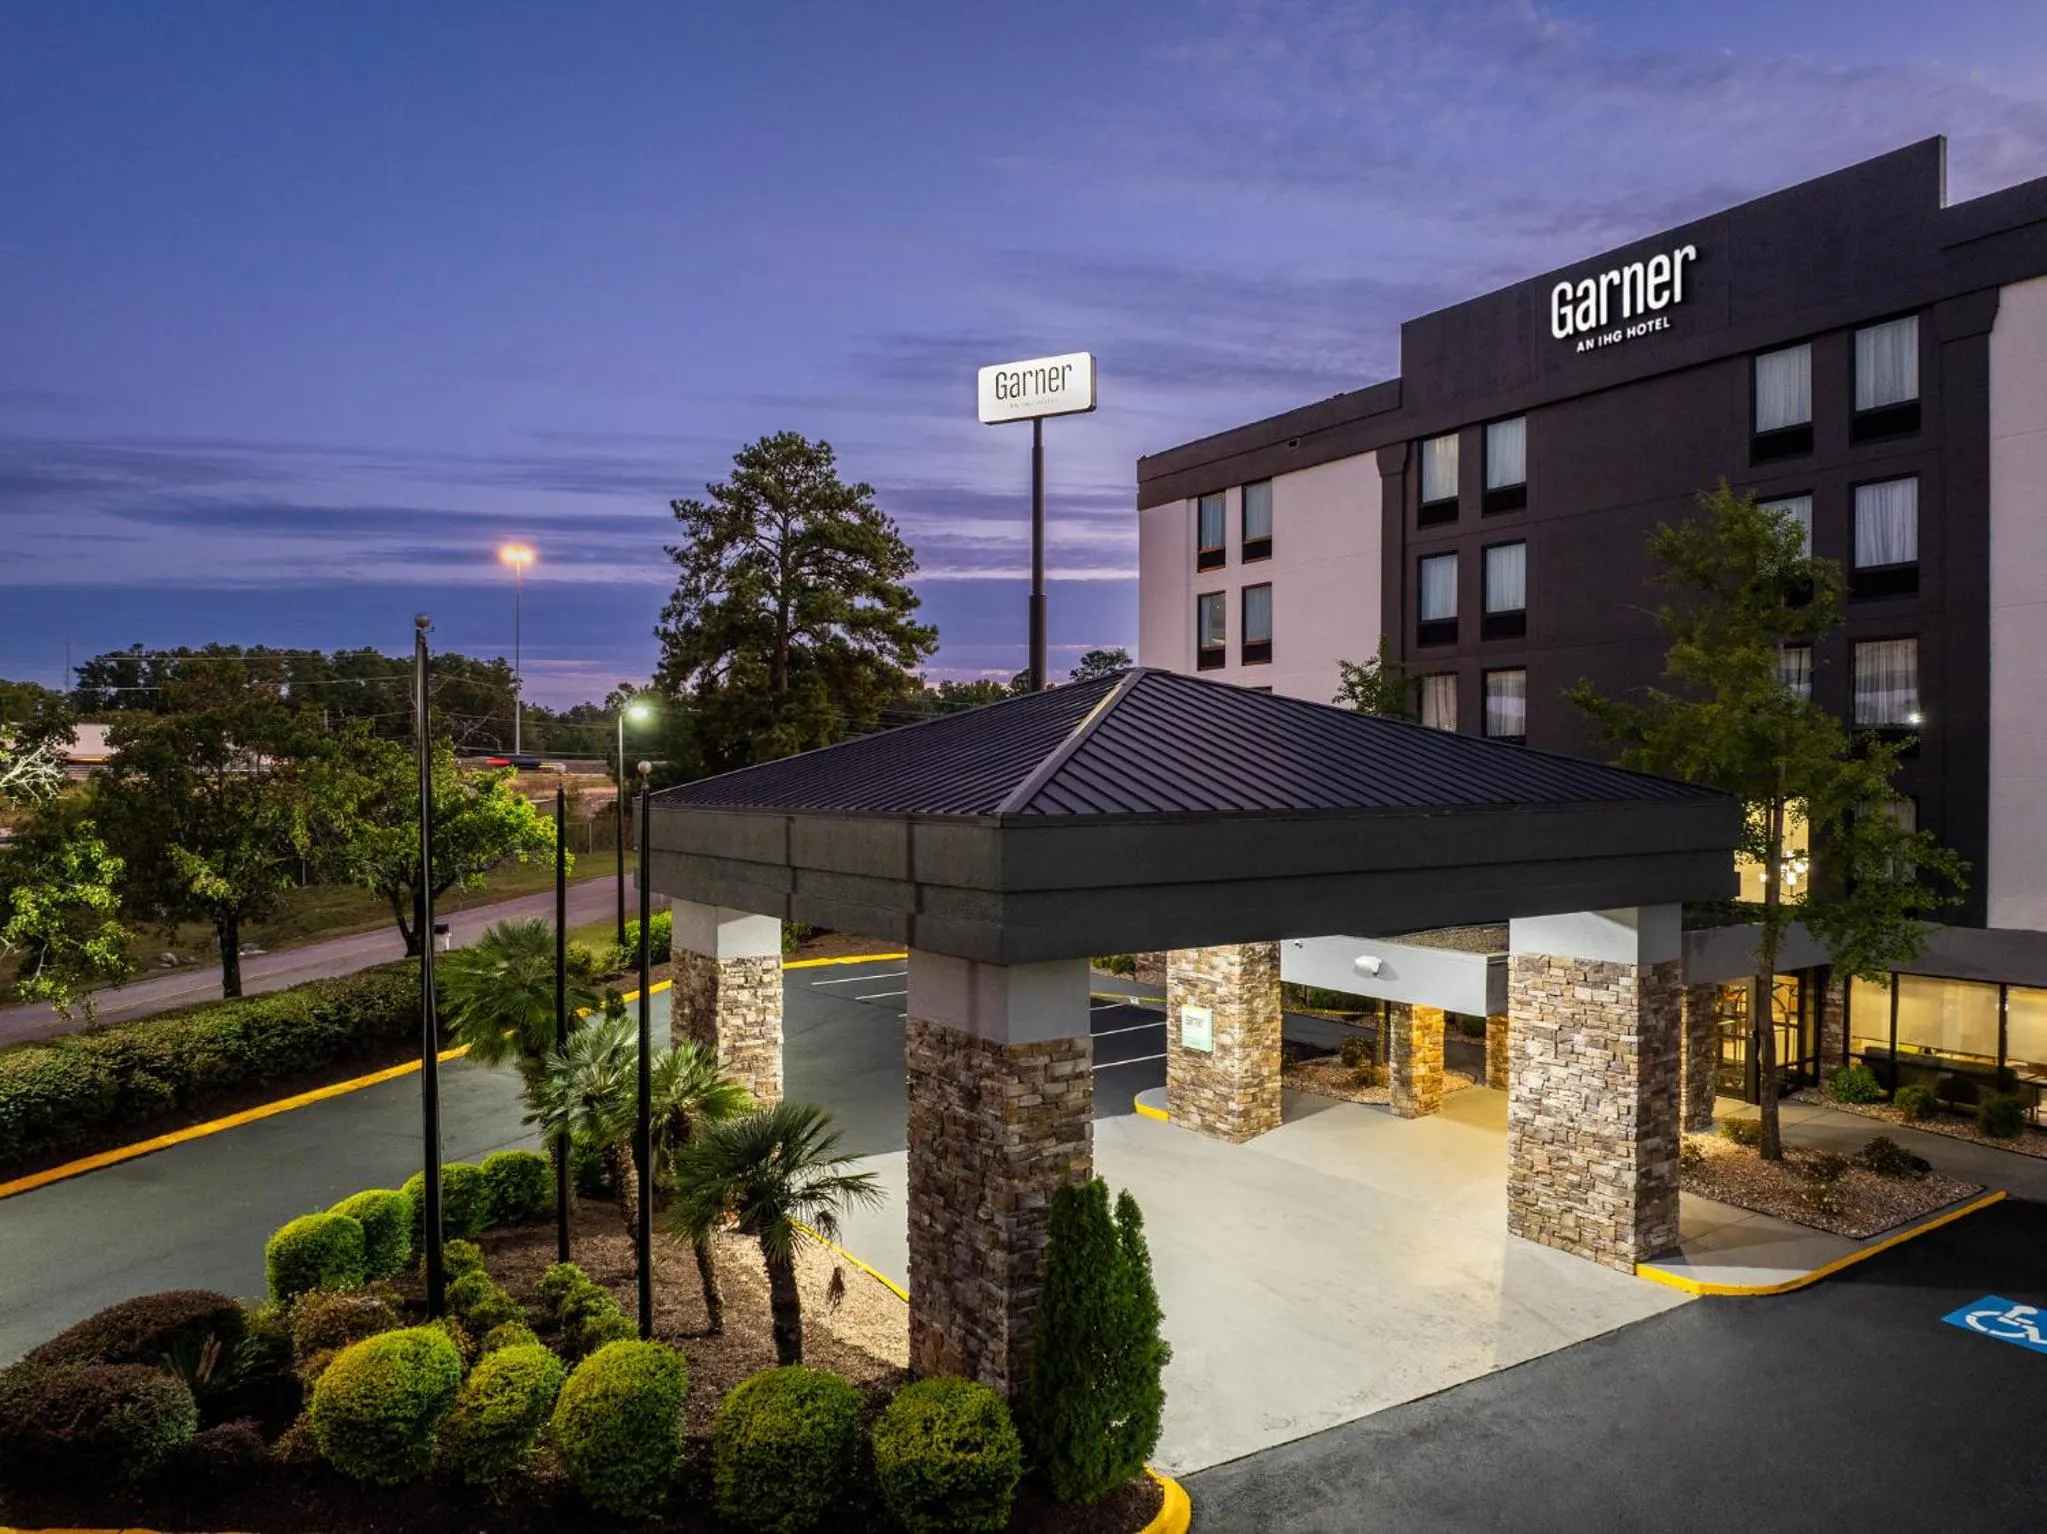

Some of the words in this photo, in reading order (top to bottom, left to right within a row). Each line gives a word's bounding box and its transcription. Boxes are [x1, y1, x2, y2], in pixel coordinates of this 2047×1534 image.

[1551, 244, 1697, 340] Garner
[1576, 338, 1595, 353] AN
[1598, 330, 1623, 348] IHG
[1626, 316, 1671, 339] HOTEL
[995, 363, 1072, 400] Garner
